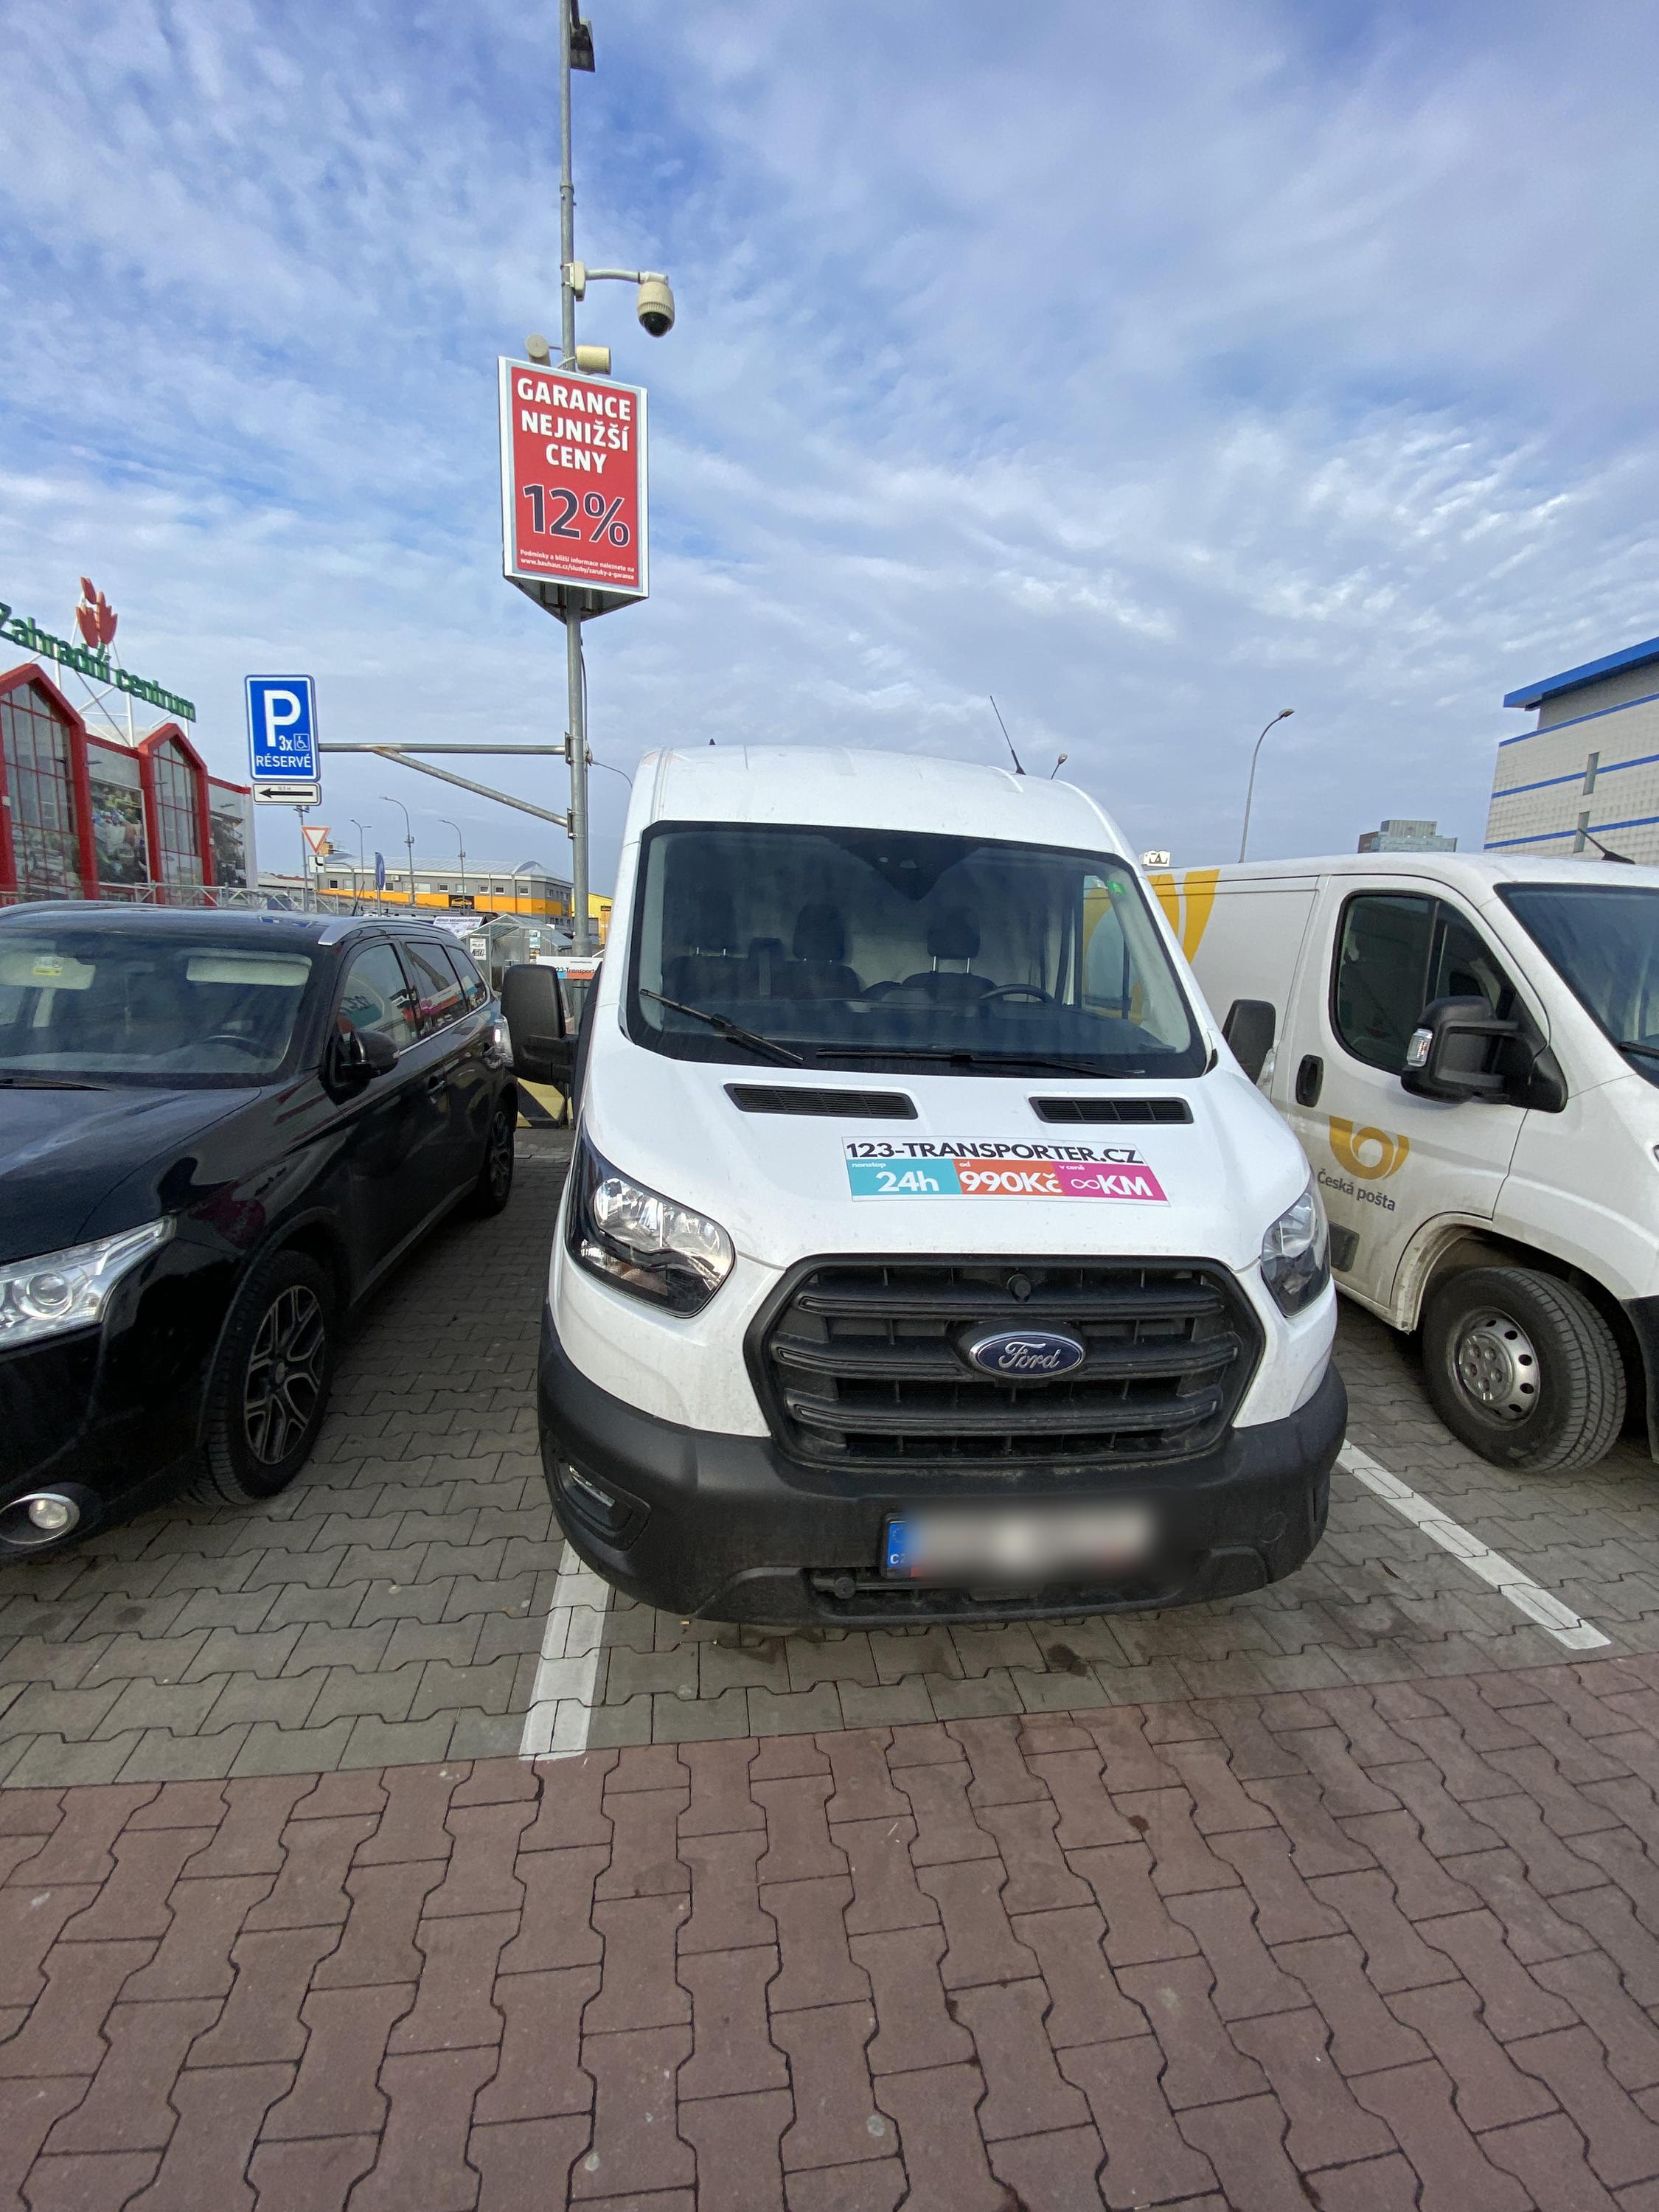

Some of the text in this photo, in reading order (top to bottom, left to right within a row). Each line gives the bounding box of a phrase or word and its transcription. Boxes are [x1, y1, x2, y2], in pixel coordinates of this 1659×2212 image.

[517, 378, 631, 421] GARANCE
[521, 410, 628, 451] NEJNIŽŠÍ
[546, 443, 607, 474] CENY
[523, 484, 630, 547] 12%
[571, 557, 599, 567] informace
[599, 563, 627, 572] naleznete
[116, 668, 196, 723] centrum
[264, 690, 301, 747] P
[279, 735, 293, 751] 3x
[256, 753, 311, 768] RÉSERVÉ
[846, 1142, 1144, 1164] 123-TRANSPORTER.CZ
[876, 1170, 939, 1192] 24h
[959, 1171, 1063, 1193] 990Kč
[1318, 1169, 1395, 1211] Česká pošta
[998, 1341, 1060, 1369] Ford
